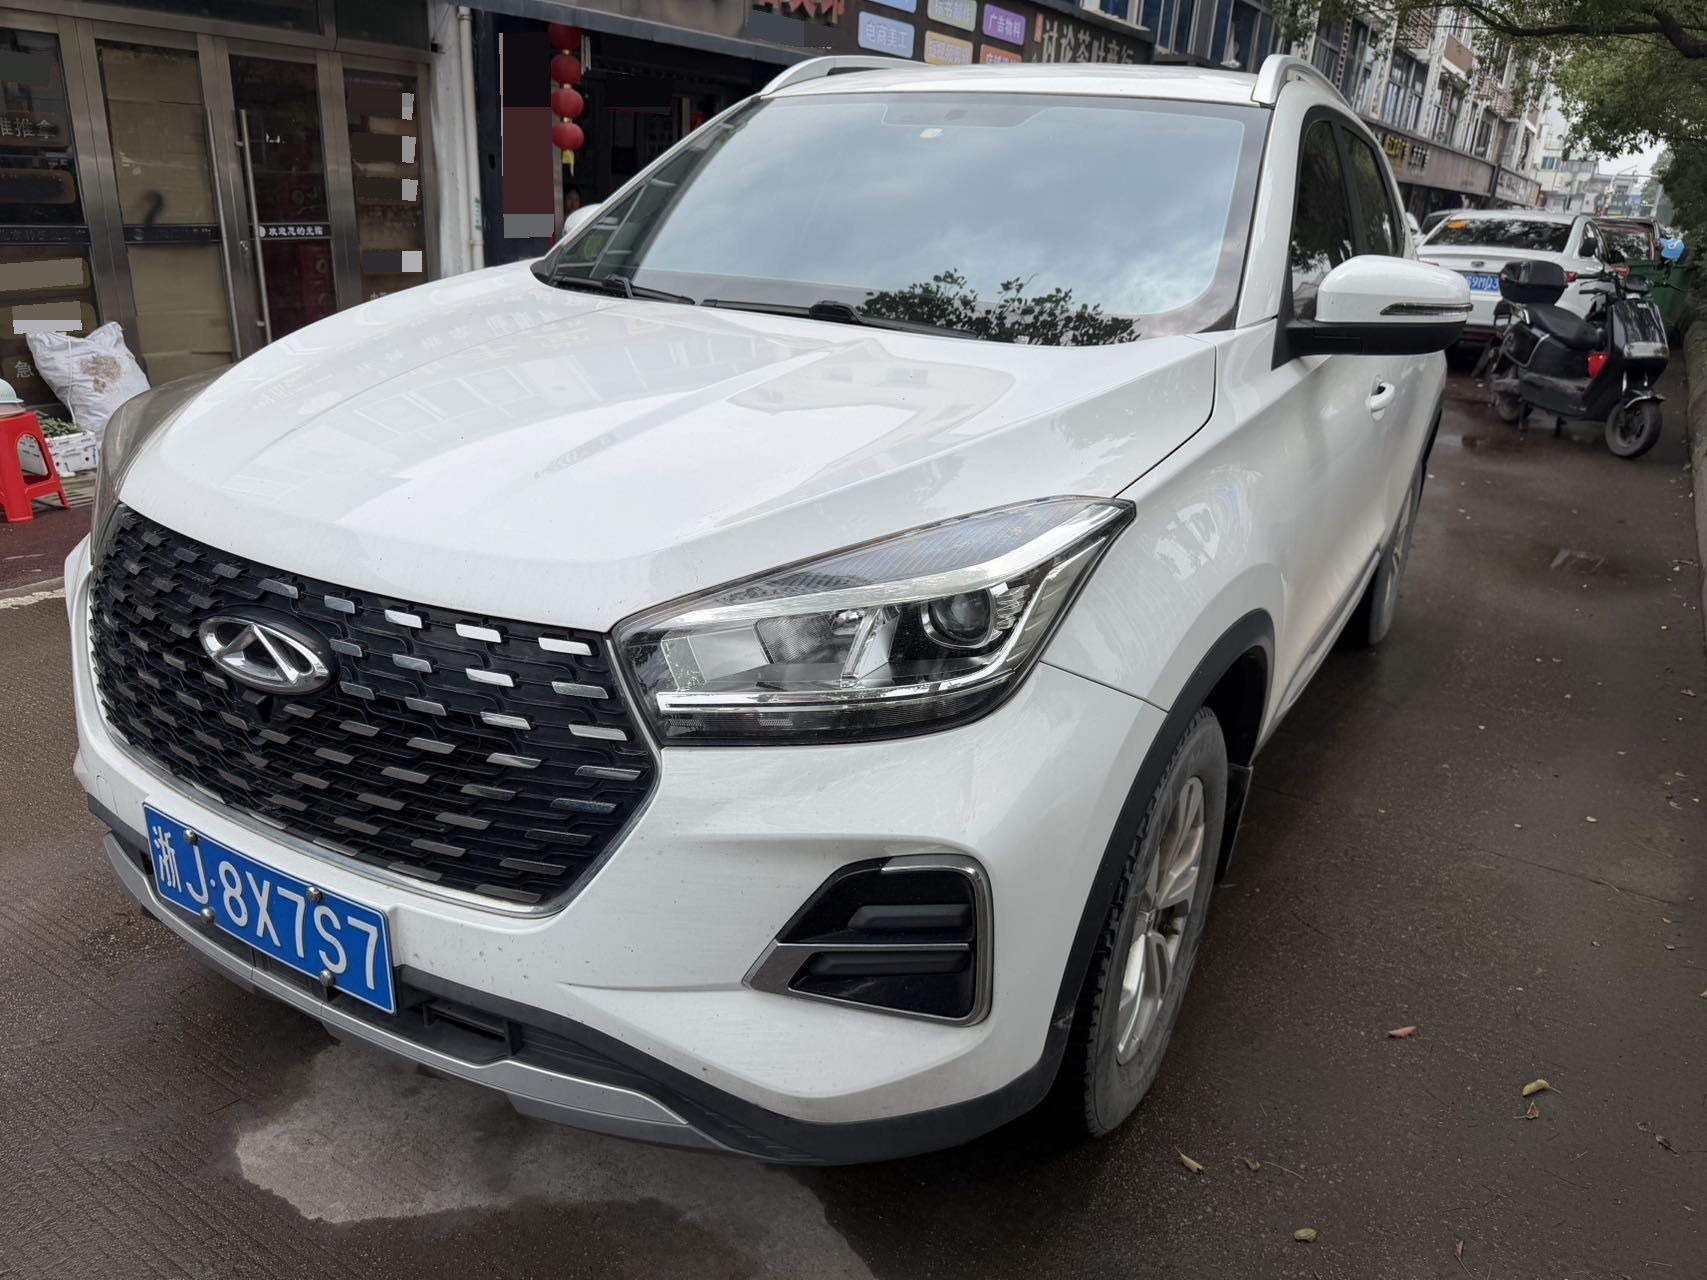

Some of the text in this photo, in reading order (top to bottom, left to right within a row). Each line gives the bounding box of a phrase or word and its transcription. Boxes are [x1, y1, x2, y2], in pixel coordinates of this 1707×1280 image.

[865, 21, 908, 49] 电商美工
[988, 13, 1021, 39] 广告物料
[268, 226, 324, 237] 欢迎您的光临
